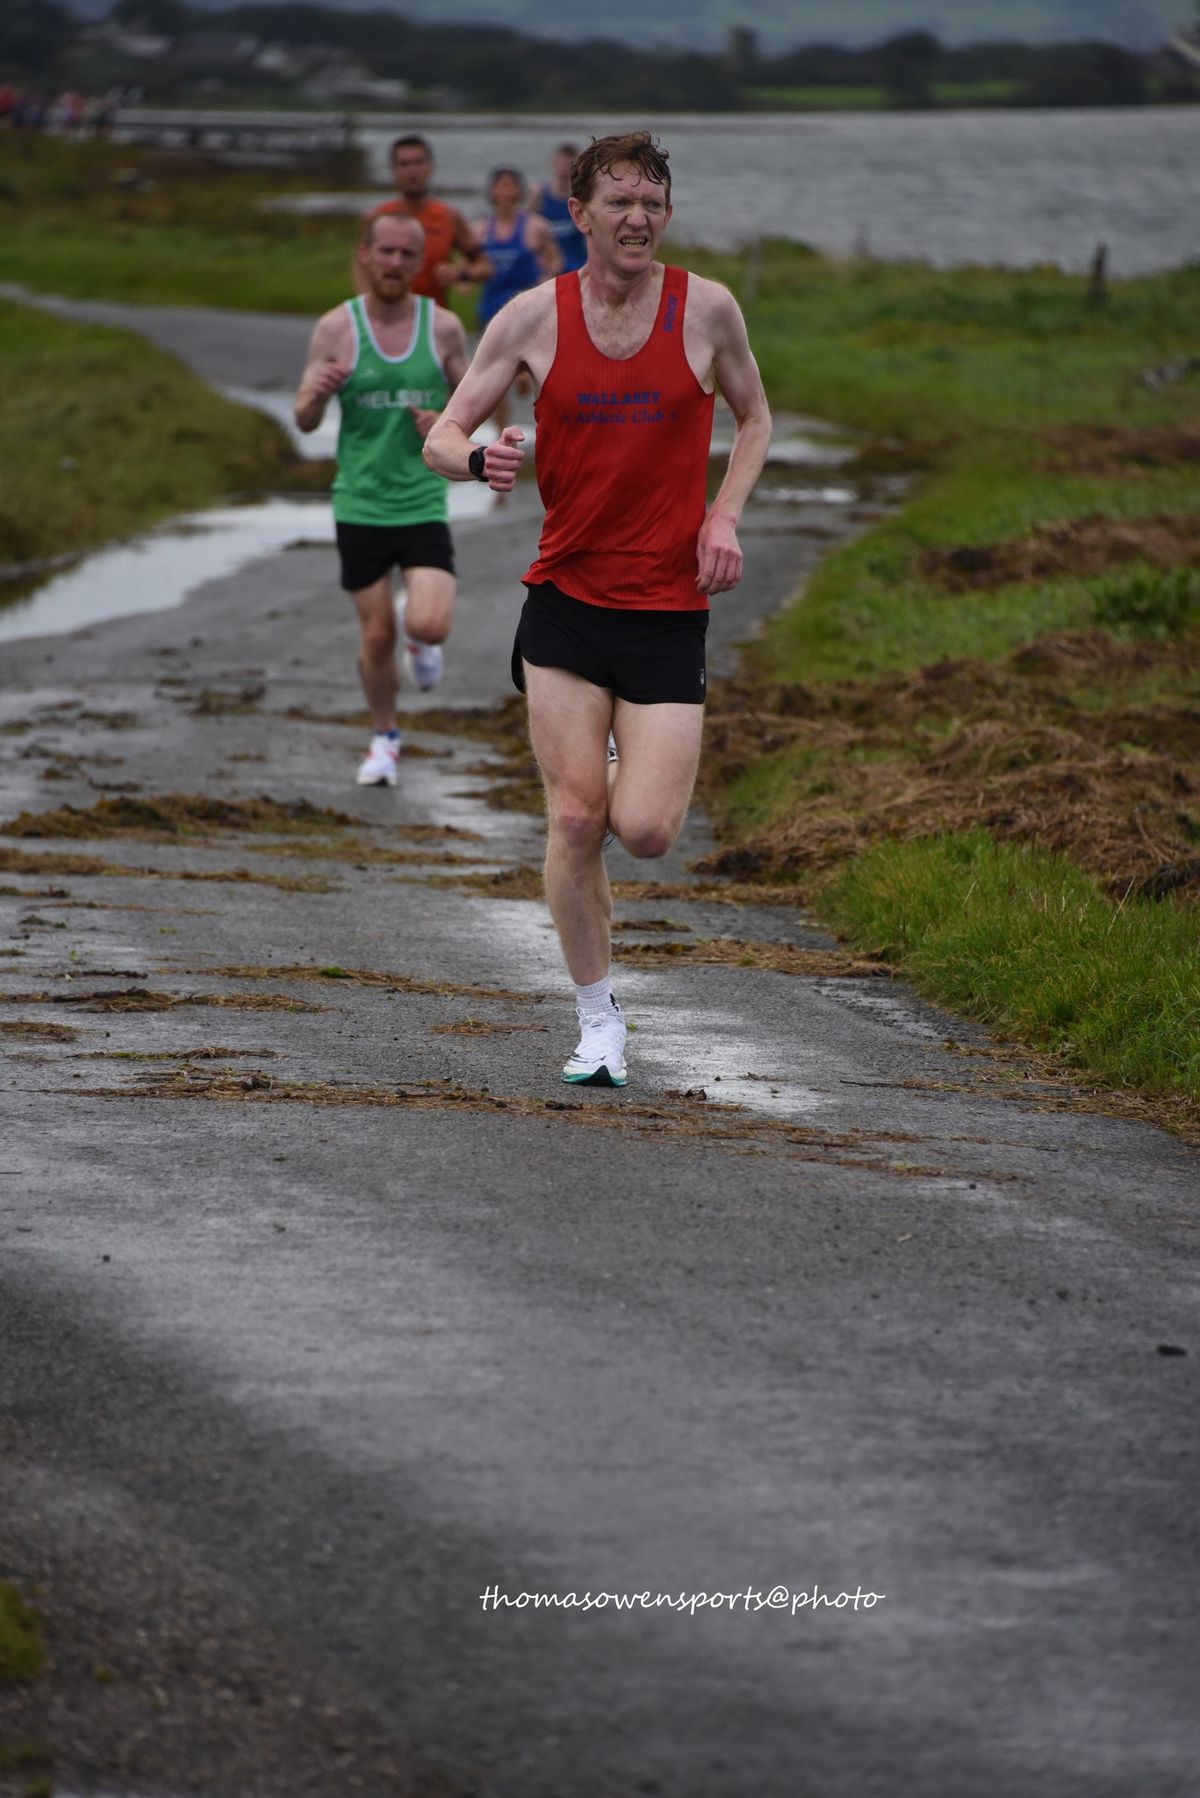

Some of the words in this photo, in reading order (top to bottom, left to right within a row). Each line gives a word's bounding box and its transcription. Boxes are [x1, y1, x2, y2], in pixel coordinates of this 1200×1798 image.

[577, 391, 661, 405] WALLASEY
[576, 410, 627, 424] Athletic
[632, 410, 664, 423] Club
